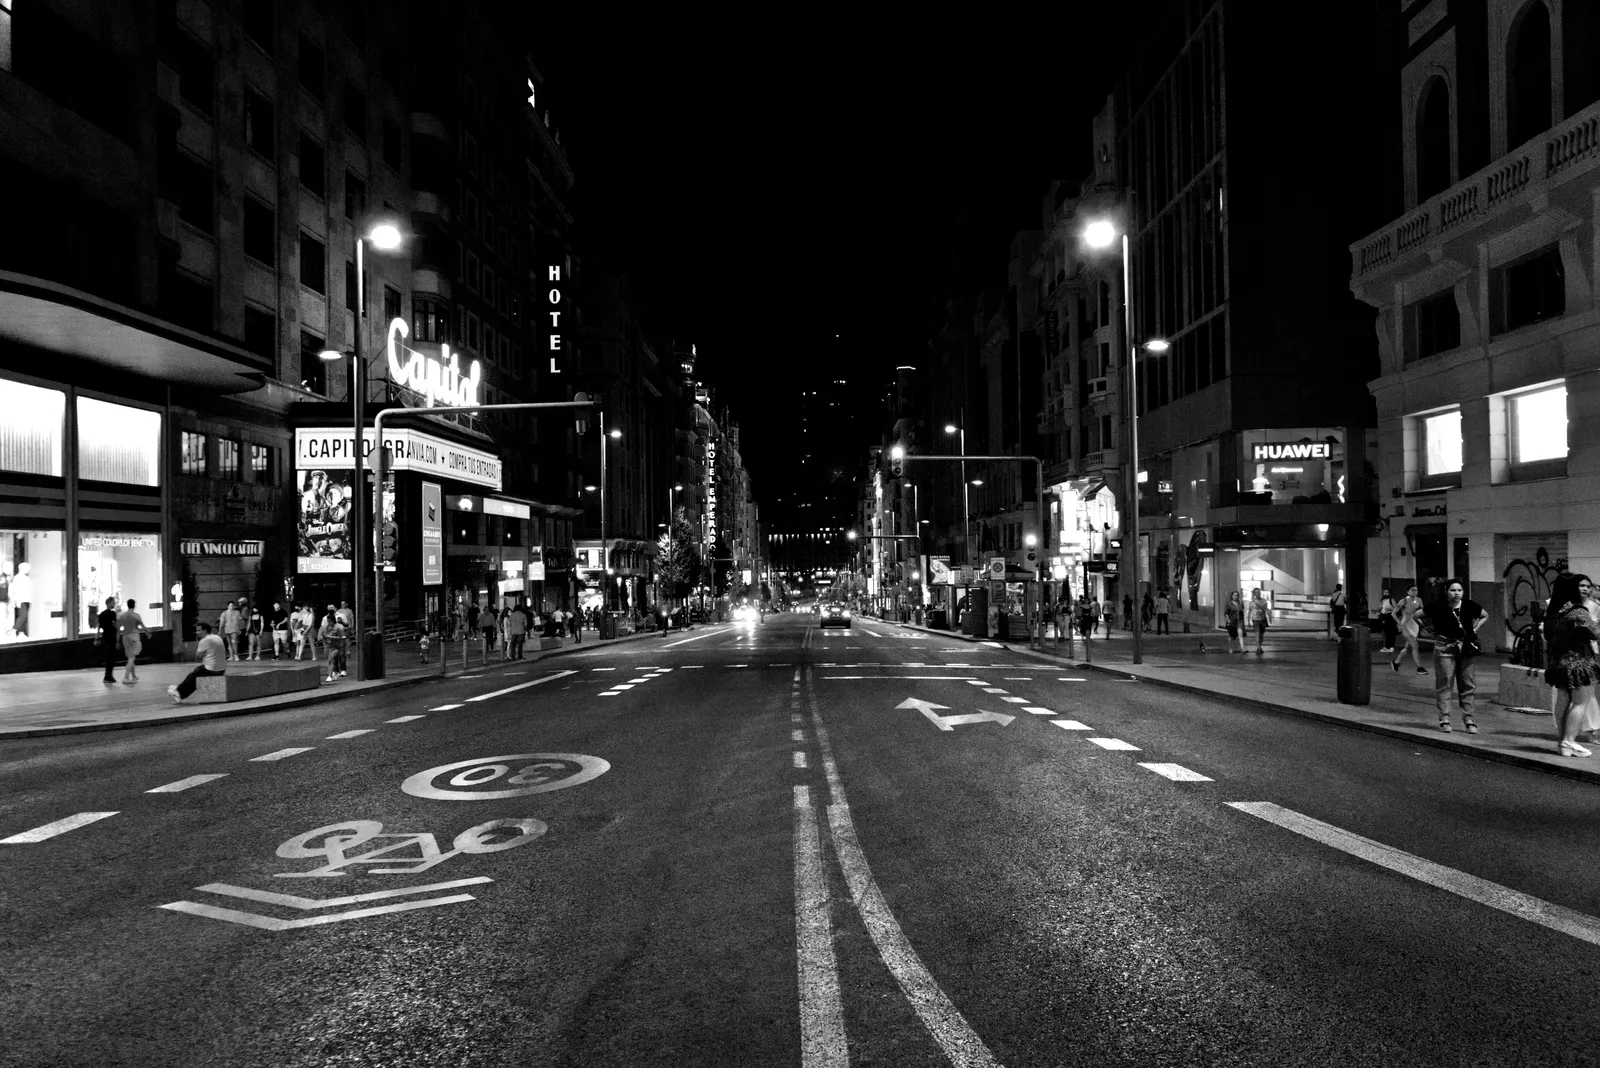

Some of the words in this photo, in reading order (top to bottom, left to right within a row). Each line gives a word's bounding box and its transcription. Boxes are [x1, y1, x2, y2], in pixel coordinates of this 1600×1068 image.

[548, 265, 561, 374] HOTEL
[388, 317, 480, 408] Capitol
[448, 451, 467, 472] COMPRA
[468, 456, 476, 475] TUS
[476, 459, 496, 480] ENTRADAS
[708, 443, 717, 484] HOTEL
[1253, 444, 1330, 459] HUAWEI
[708, 488, 719, 558] EMPERADO
[102, 538, 123, 547] COLORS
[449, 762, 567, 786] 30
